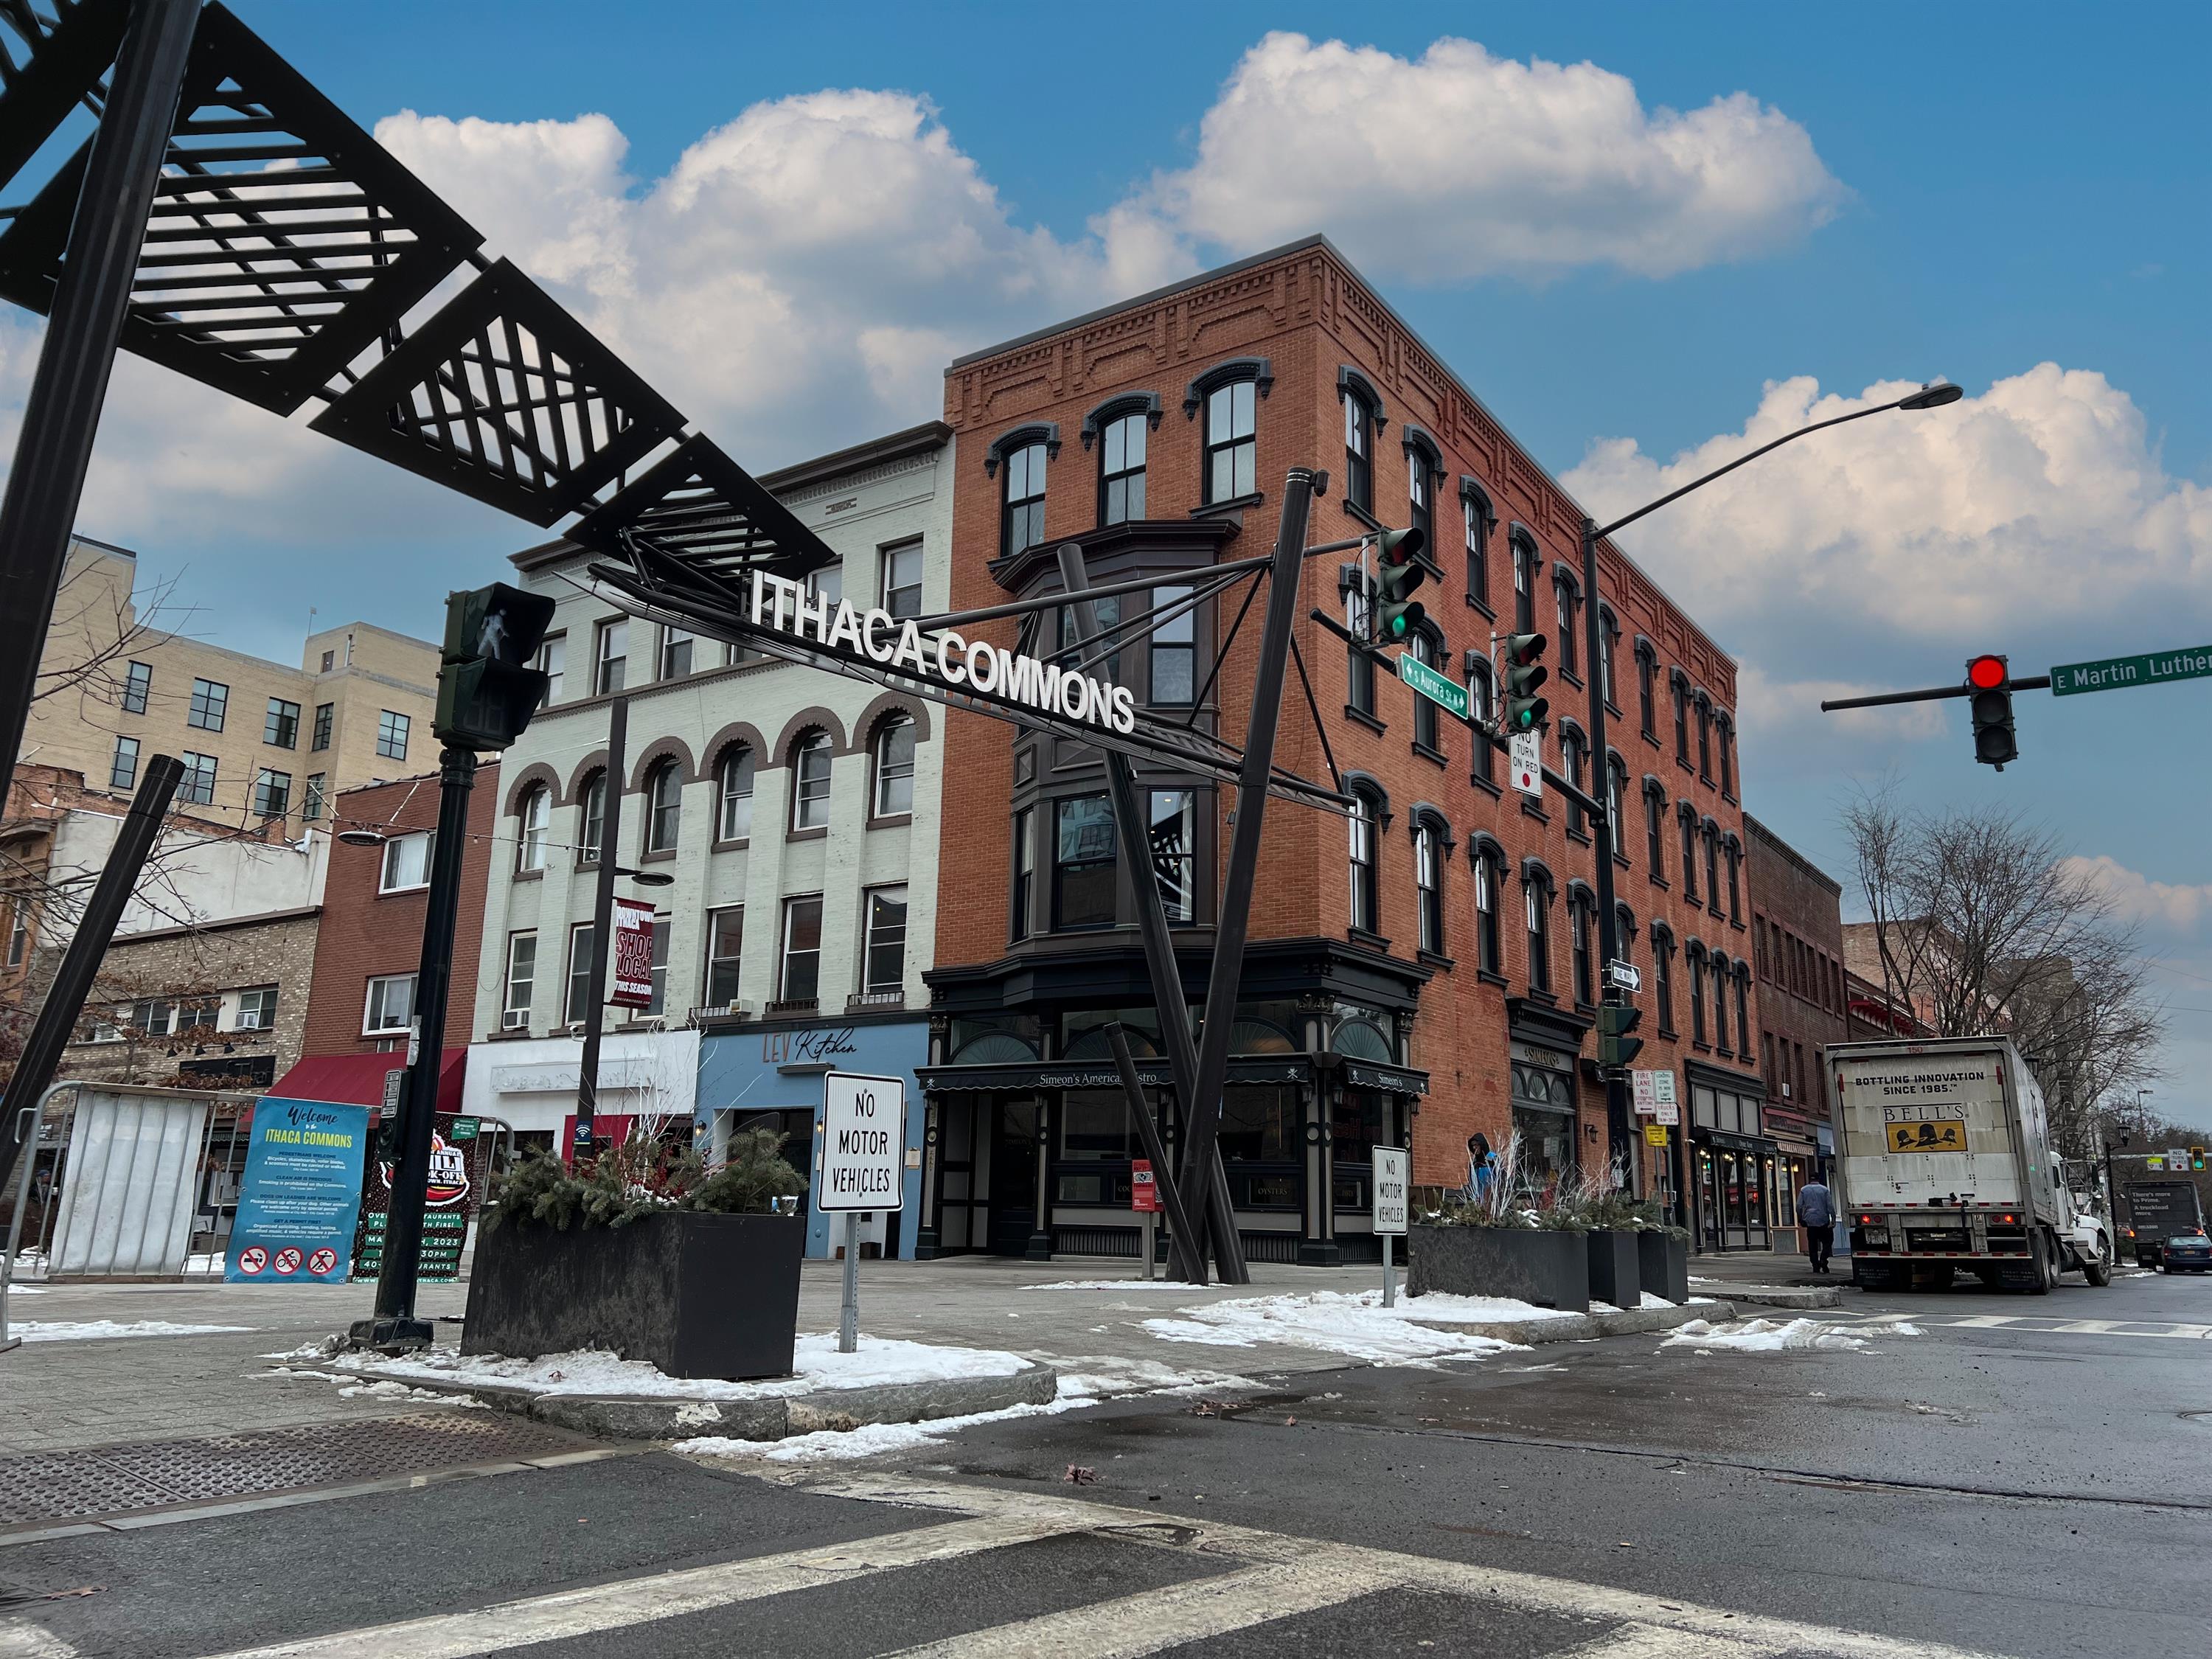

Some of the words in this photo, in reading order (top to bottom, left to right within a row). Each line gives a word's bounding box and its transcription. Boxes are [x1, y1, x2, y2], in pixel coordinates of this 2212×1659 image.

[751, 569, 928, 675] ITHACA
[936, 631, 1135, 734] COMMONS
[2057, 675, 2066, 688] E
[2073, 663, 2137, 686] Martin
[1421, 670, 1444, 698] Aurora
[1445, 689, 1452, 703] St
[1518, 733, 1531, 743] NO
[1517, 744, 1534, 759] TURN
[1513, 757, 1522, 768] ON
[1526, 761, 1538, 773] RED
[617, 906, 654, 922] DOWNTOWN
[616, 931, 653, 959] SHOP
[616, 955, 653, 980] LOCAL
[615, 981, 629, 992] THIS
[629, 982, 652, 995] SEASON
[762, 1032, 791, 1062] LEV
[796, 1026, 857, 1062] Kitchen
[1040, 1074, 1079, 1085] Simeon's
[1081, 1073, 1122, 1083] America
[1135, 1072, 1156, 1082] istro
[1379, 1073, 1402, 1086] Simeon's
[1855, 1076, 1910, 1085] BOTTLING
[1914, 1072, 1984, 1082] INNOVATION
[1883, 1086, 1916, 1095] SINCE
[855, 1093, 874, 1117] NO
[288, 1106, 338, 1126] Welcome
[1884, 1106, 1964, 1121] BELL'S
[265, 1129, 300, 1144] ITHACA
[303, 1131, 352, 1148] COMMONS
[839, 1130, 888, 1155] MOTOR
[429, 1155, 462, 1172] ILI
[1386, 1159, 1395, 1175] NO
[428, 1170, 462, 1180] K-OFF
[833, 1168, 890, 1192] VEHICLES
[1258, 1187, 1287, 1195] OYSTERS
[1380, 1183, 1402, 1200] MOTOR
[1379, 1207, 1403, 1222] VEHICLES
